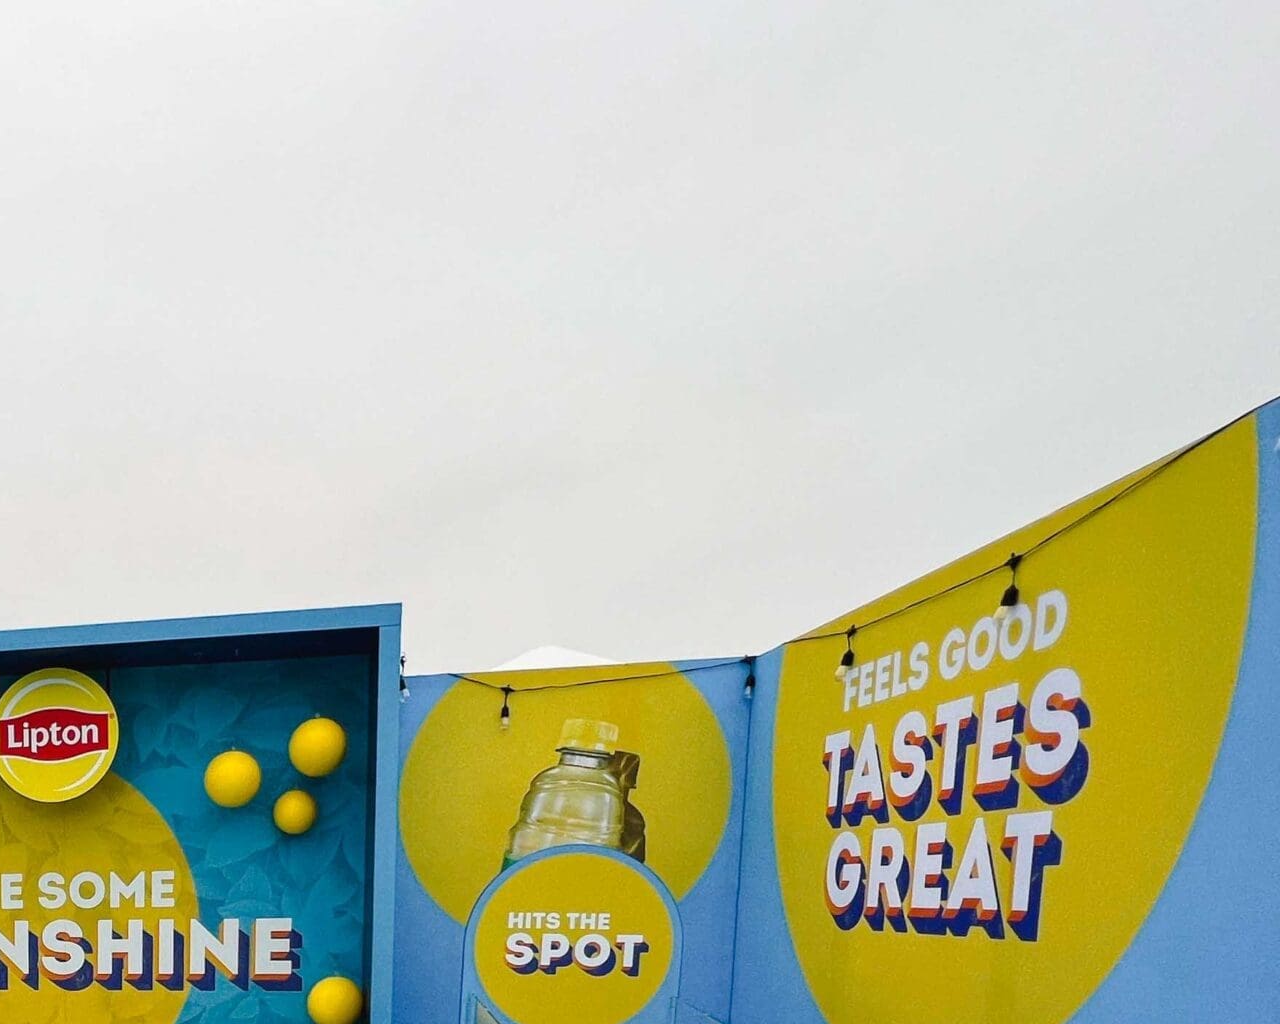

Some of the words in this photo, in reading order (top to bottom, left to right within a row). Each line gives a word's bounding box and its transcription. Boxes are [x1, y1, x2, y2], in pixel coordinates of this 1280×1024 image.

[843, 641, 929, 712] FEELS
[939, 590, 1068, 681] GOOD
[7, 718, 99, 753] Lipton
[822, 668, 1091, 829] TASTES
[38, 870, 175, 909] SOME
[824, 811, 1062, 942] GREAT
[507, 911, 561, 930] HITS
[567, 912, 611, 930] THE
[505, 932, 650, 977] SPOT
